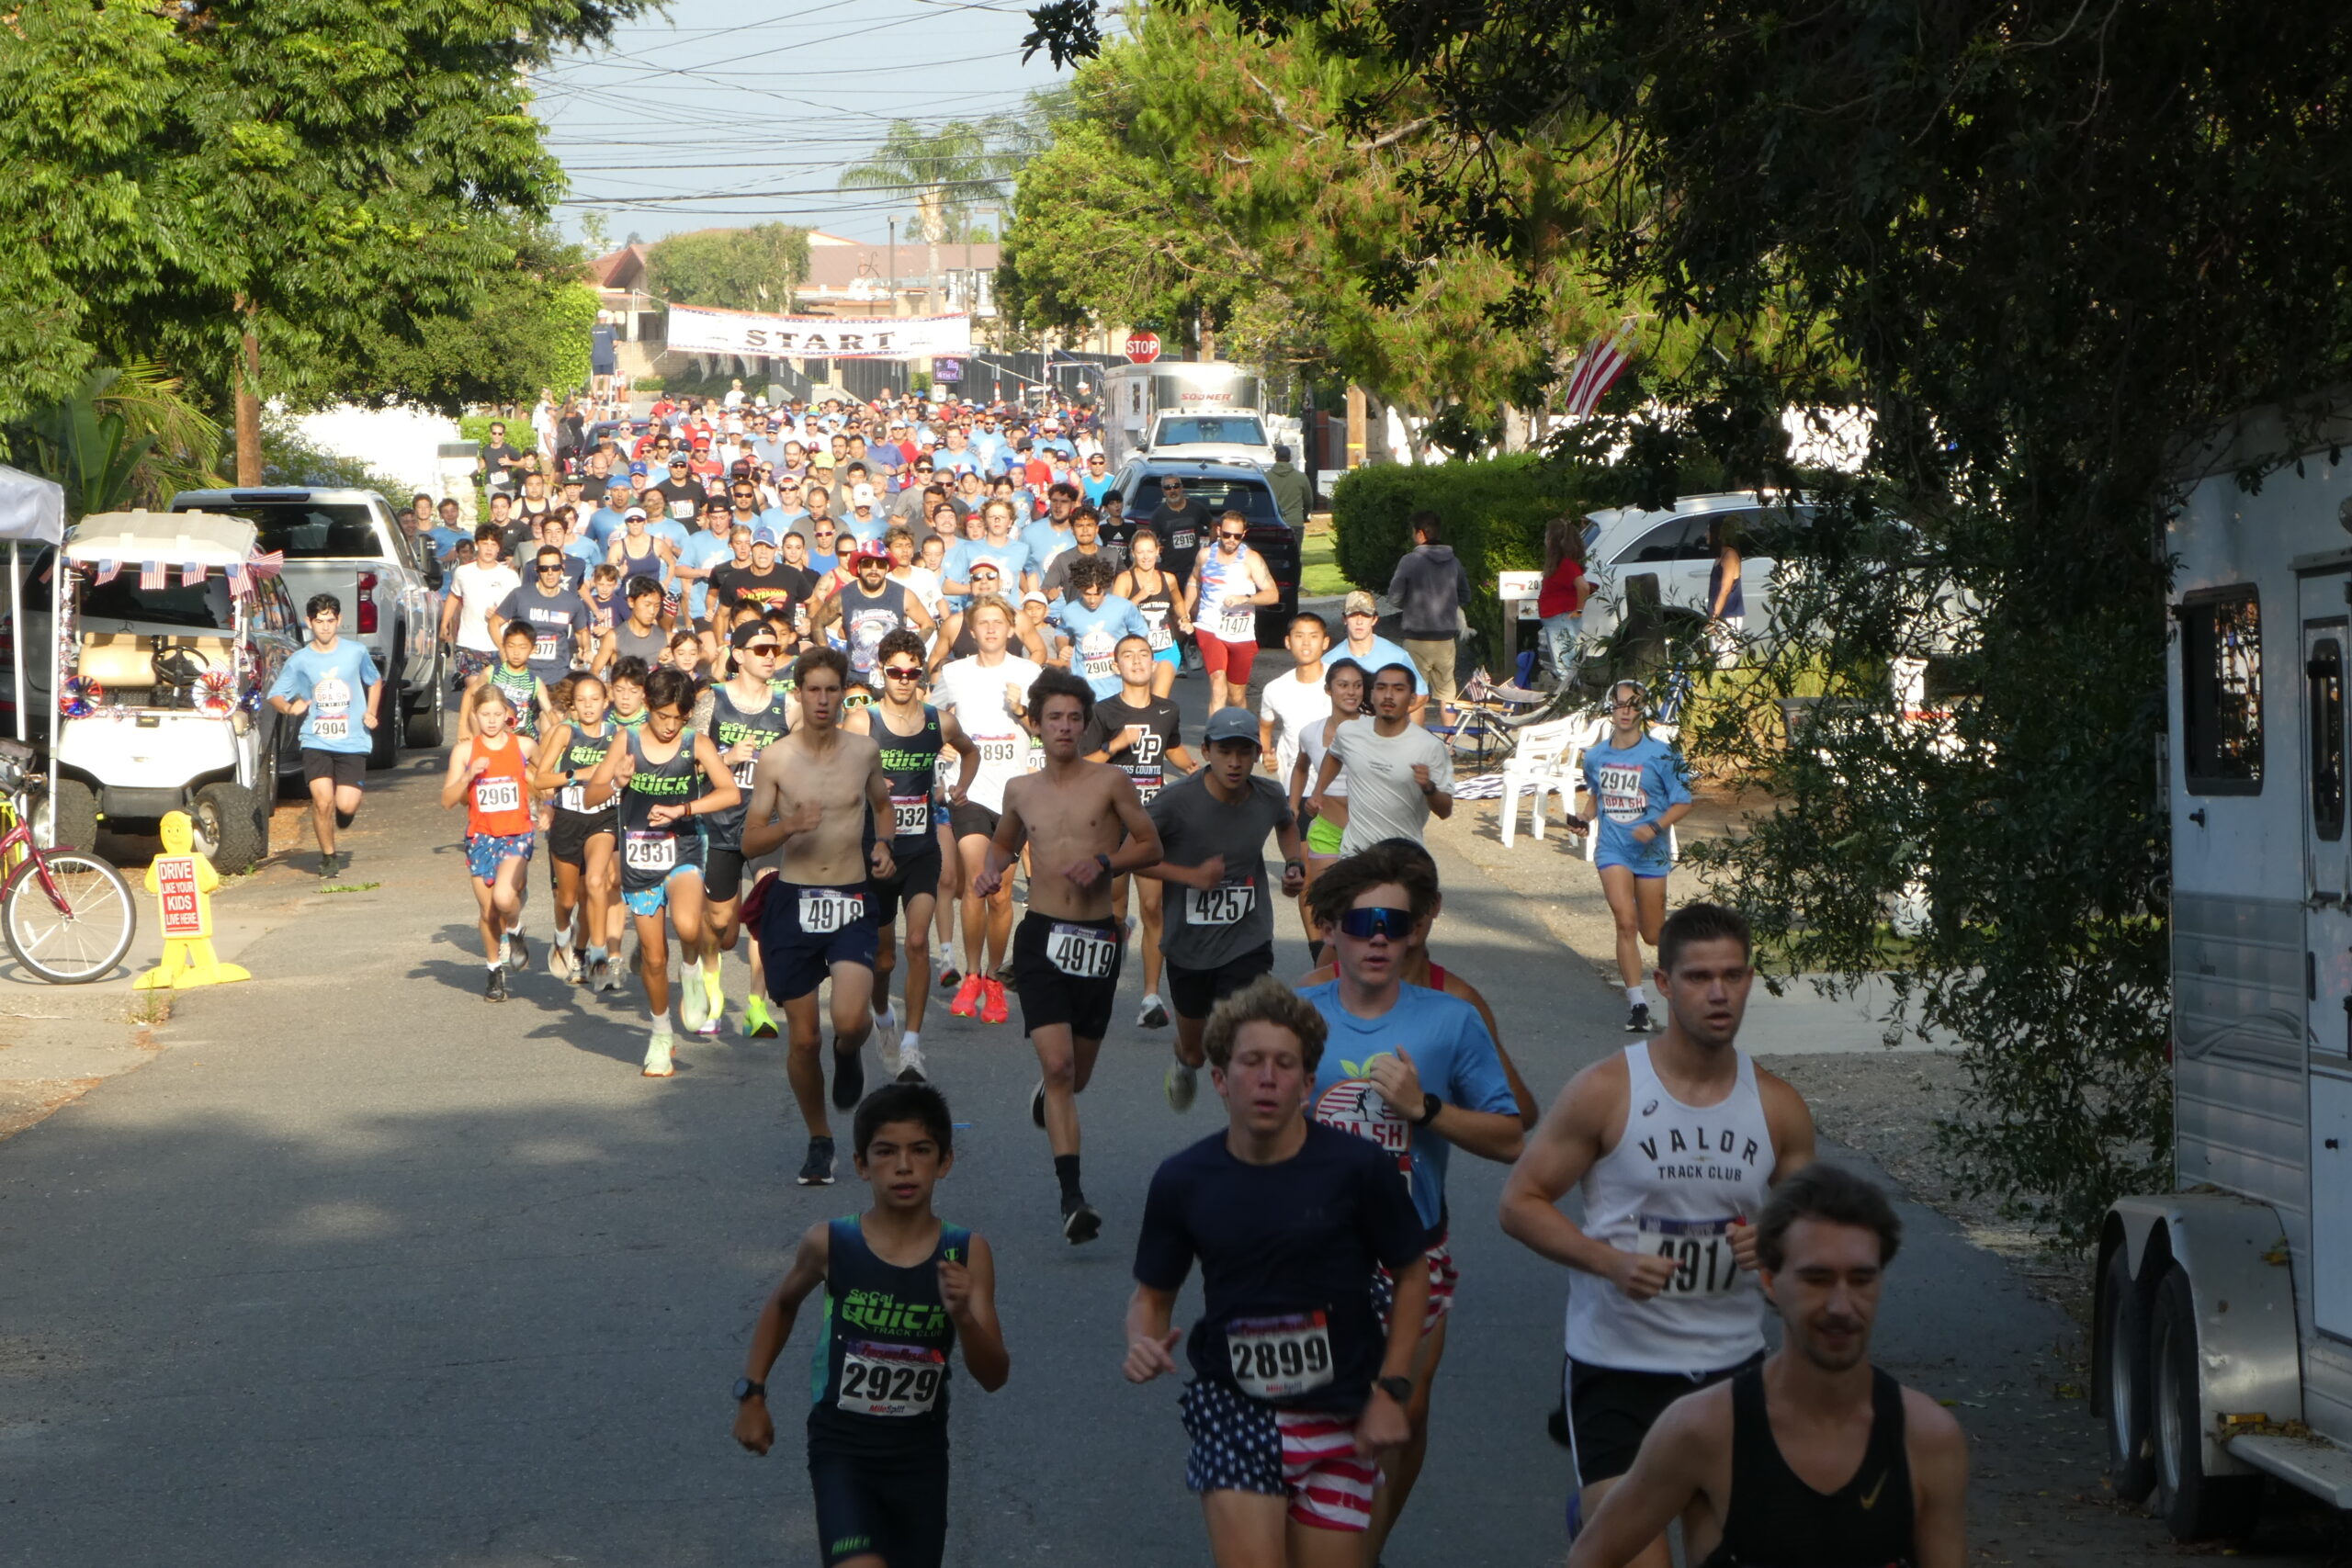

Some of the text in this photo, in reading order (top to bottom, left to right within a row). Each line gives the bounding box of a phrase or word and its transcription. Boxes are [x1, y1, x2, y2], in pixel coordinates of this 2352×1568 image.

[745, 329, 896, 350] START
[1126, 341, 1158, 355] STOP
[1175, 535, 1194, 546] 2919
[529, 608, 549, 622] USA
[1225, 617, 1250, 633] 1477
[314, 722, 346, 734] 2904
[571, 749, 606, 764] QUIC
[881, 752, 937, 770] QUICK
[629, 775, 691, 793] QUICK
[1600, 772, 1638, 791] 2914
[479, 785, 518, 806] 2961
[896, 807, 926, 827] 932
[628, 843, 673, 863] 2931
[160, 862, 192, 880] DRIVE
[162, 881, 195, 894] LIKE YOUR
[166, 895, 193, 910] KIDS
[1195, 888, 1253, 921] 4257
[165, 912, 197, 925] LIVE HERE
[808, 899, 862, 930] 4918
[1056, 936, 1114, 976] 4919
[1639, 1127, 1758, 1166] VALOR
[1657, 1165, 1742, 1182] TRACK CLUB
[850, 1289, 894, 1303] SoCal
[842, 1296, 946, 1330] QUICK
[874, 1327, 910, 1337] TRACK
[1232, 1336, 1329, 1381] 2899
[842, 1362, 939, 1403] 2929
